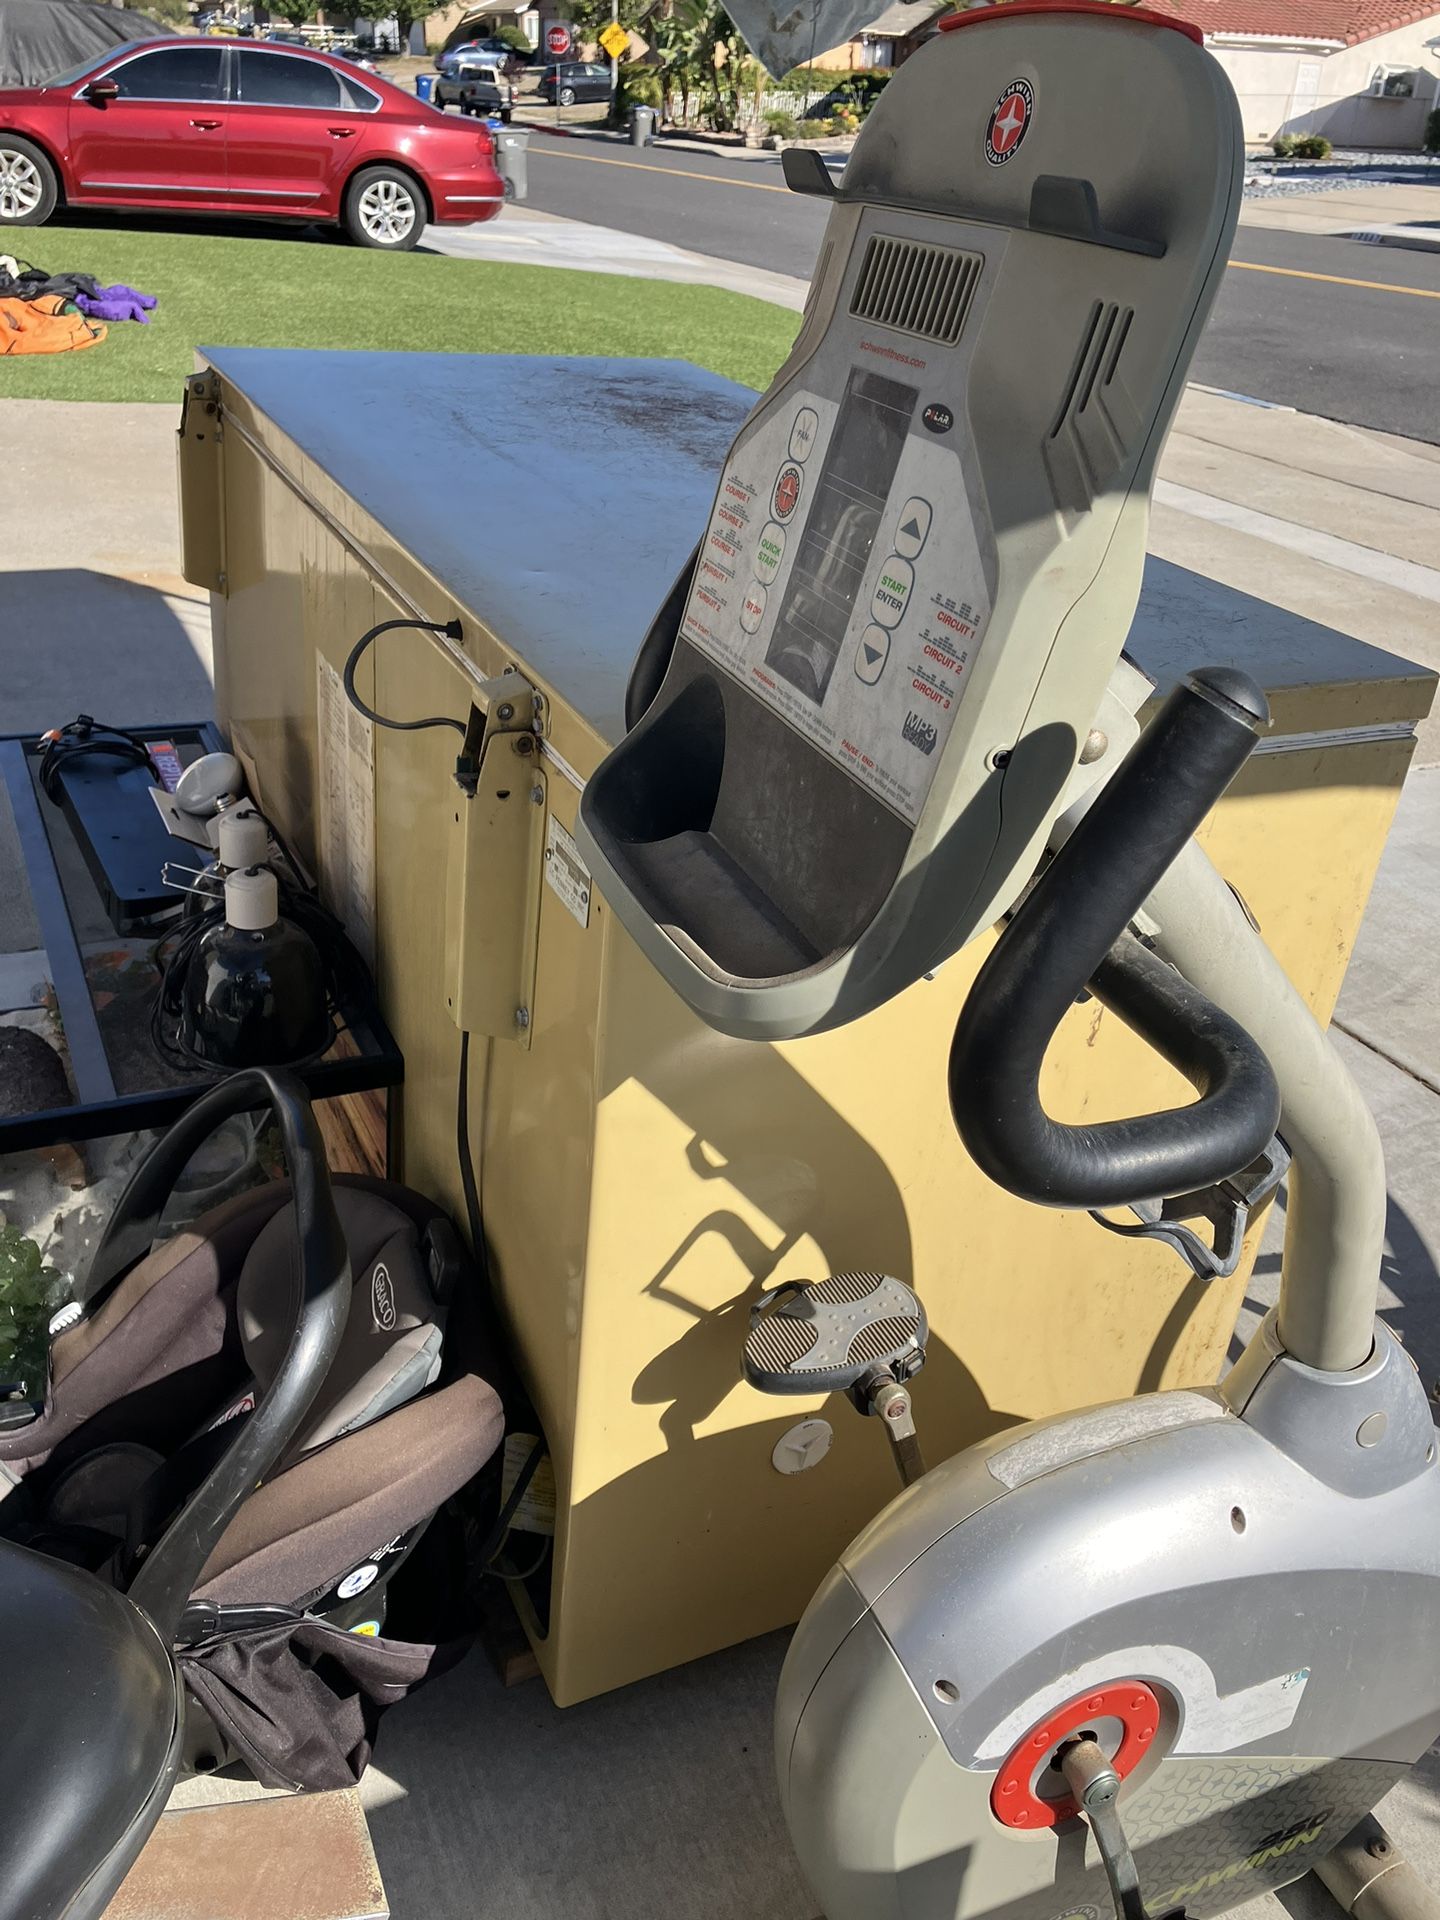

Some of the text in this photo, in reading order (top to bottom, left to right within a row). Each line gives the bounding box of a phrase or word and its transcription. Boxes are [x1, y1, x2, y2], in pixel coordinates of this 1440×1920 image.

[548, 33, 569, 45] STOP
[993, 82, 1032, 116] SCHWINN
[986, 139, 1019, 163] QUALITY
[796, 429, 810, 441] FAN
[725, 483, 747, 502] COURSE
[718, 508, 744, 529] COURSE 2
[710, 535, 732, 555] COURSE
[760, 538, 782, 557] QUICK
[757, 551, 778, 568] START
[703, 562, 725, 581] PURSUIT
[881, 575, 907, 595] START
[696, 589, 718, 610] PURSUIT
[745, 600, 762, 615] STOP
[875, 589, 903, 612] ENTER
[936, 611, 976, 640] CIRCUIT 1
[923, 645, 963, 675] CIRCUIT 2
[912, 678, 951, 709] CIRCUIT 3
[906, 712, 937, 741] MP3
[841, 738, 859, 757] PAUSE
[375, 1272, 393, 1324] GRACO
[1143, 1823, 1325, 1915] CHWINN
